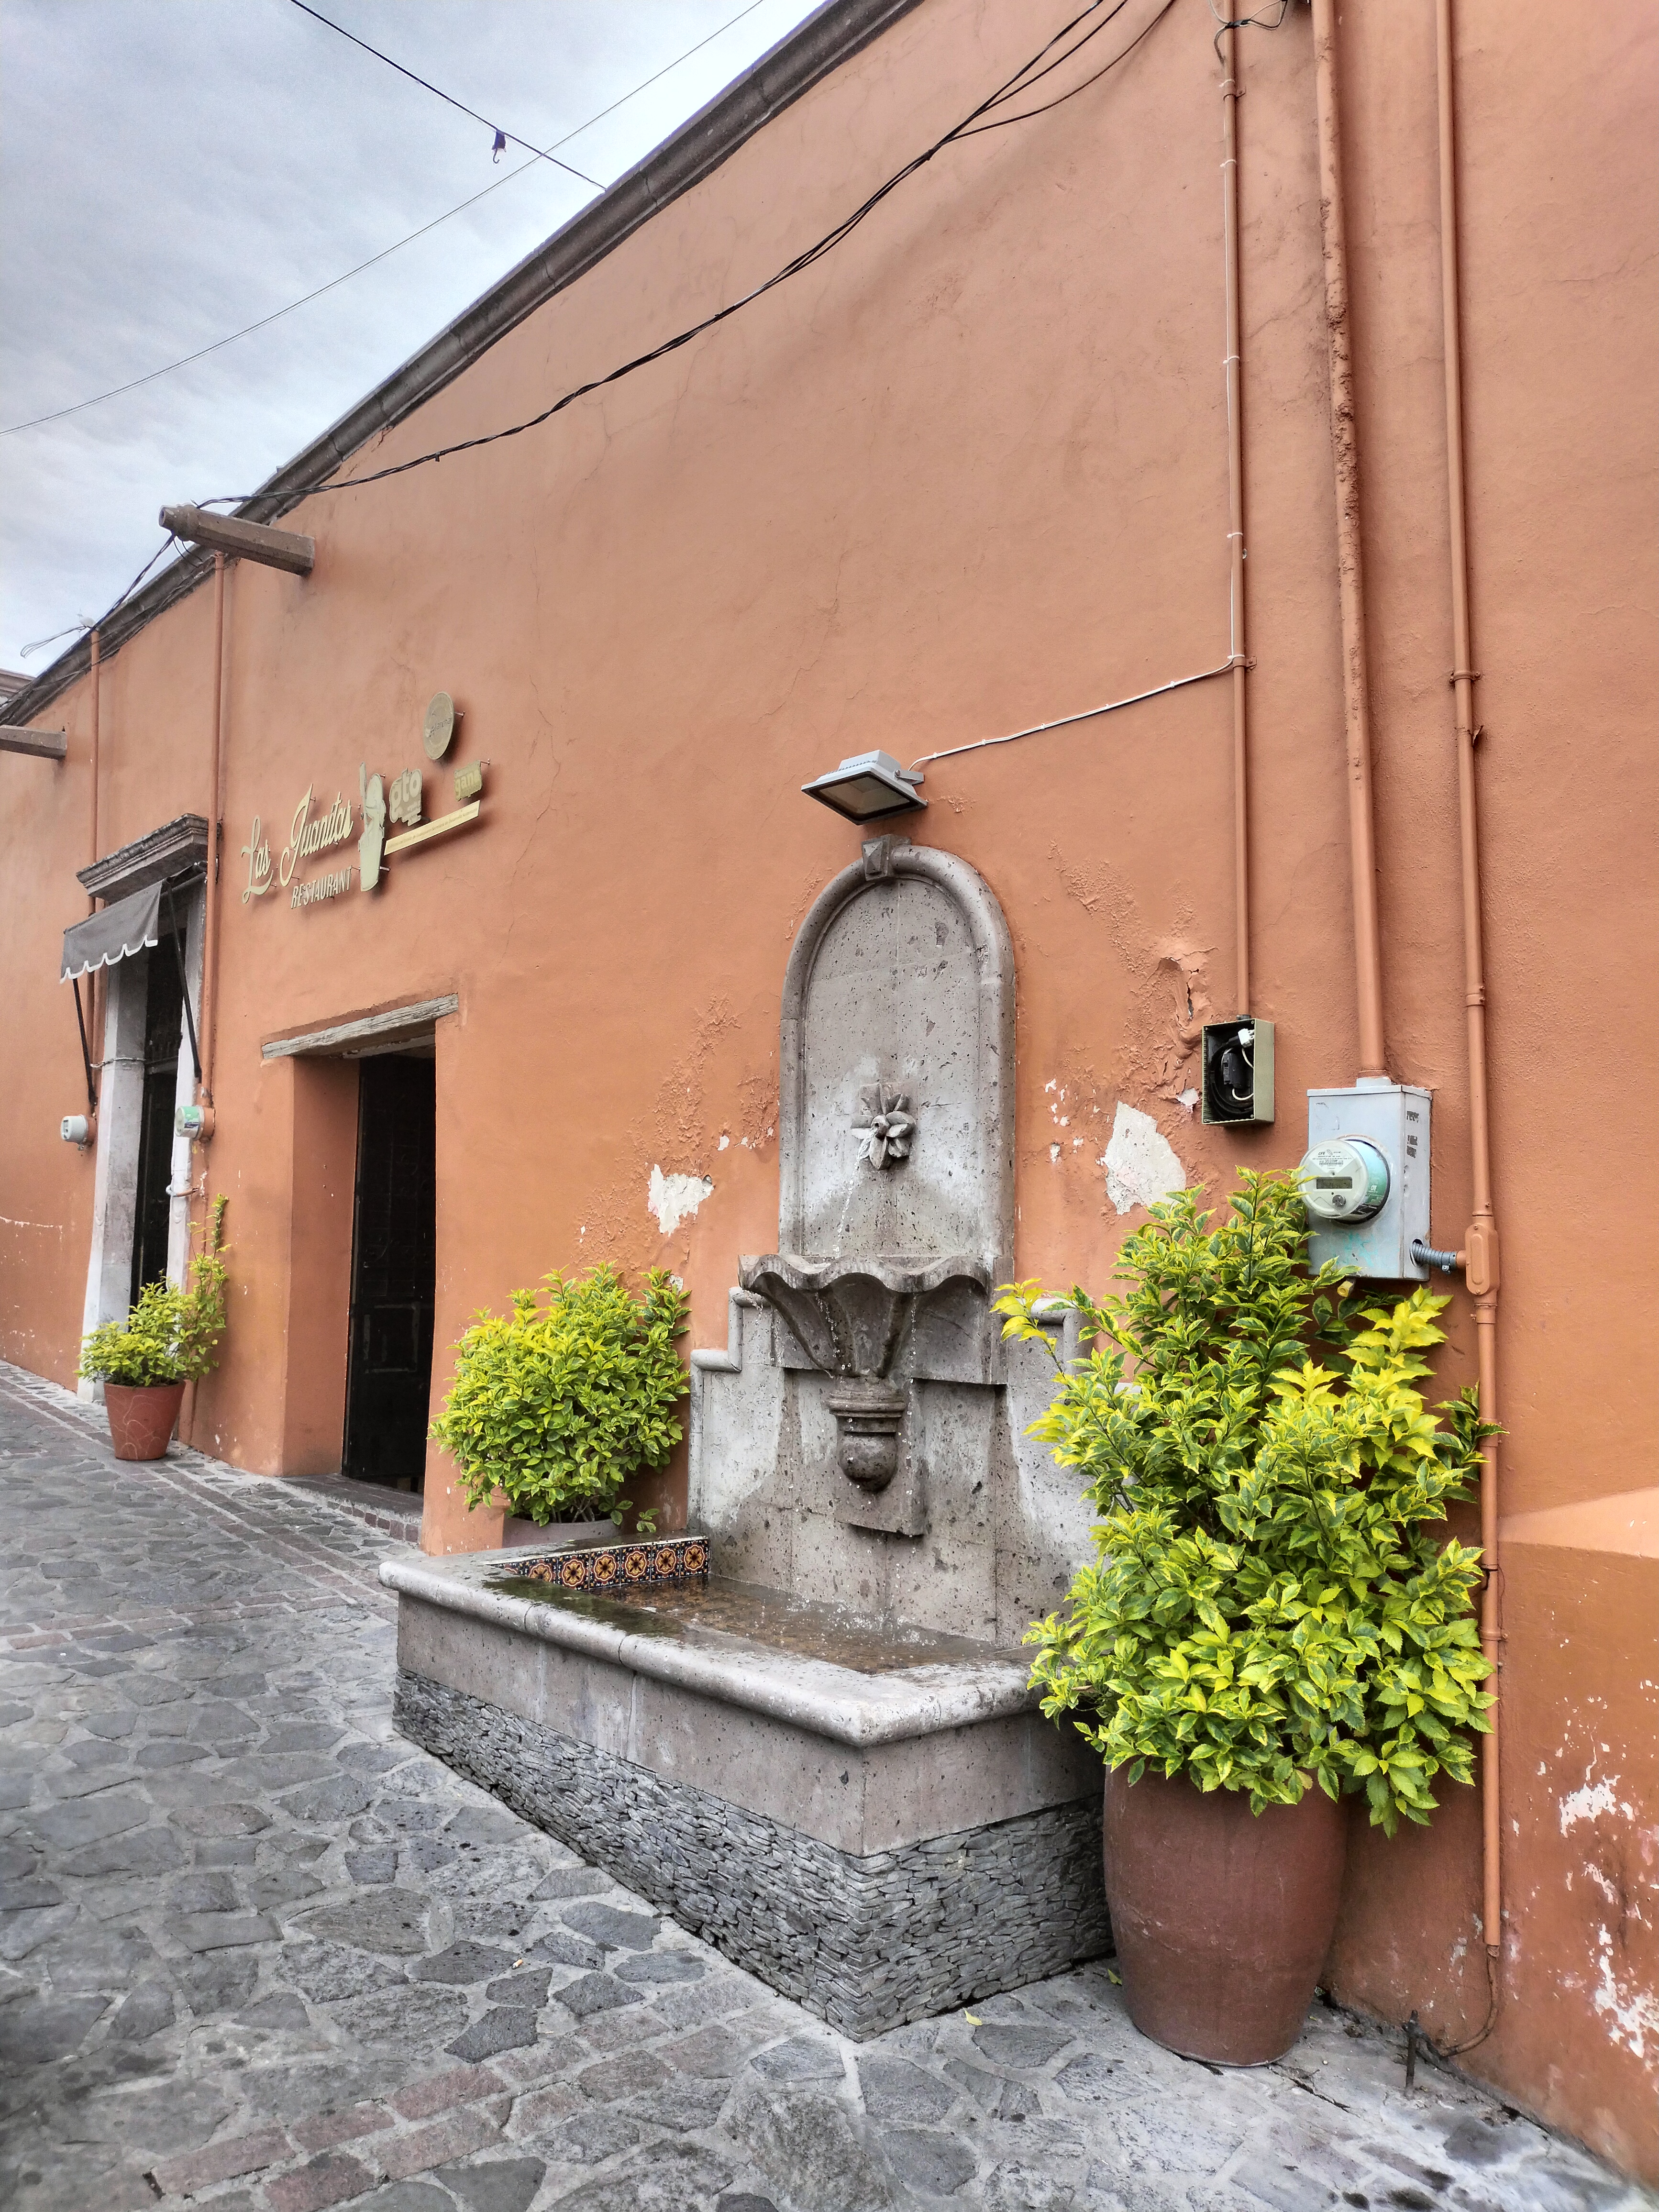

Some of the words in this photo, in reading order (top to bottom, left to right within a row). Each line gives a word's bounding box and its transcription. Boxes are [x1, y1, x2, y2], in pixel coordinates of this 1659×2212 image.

[391, 770, 421, 821] gto
[241, 816, 273, 904] Las
[280, 783, 353, 886] Juanitas
[290, 865, 353, 909] RESTAURANT
